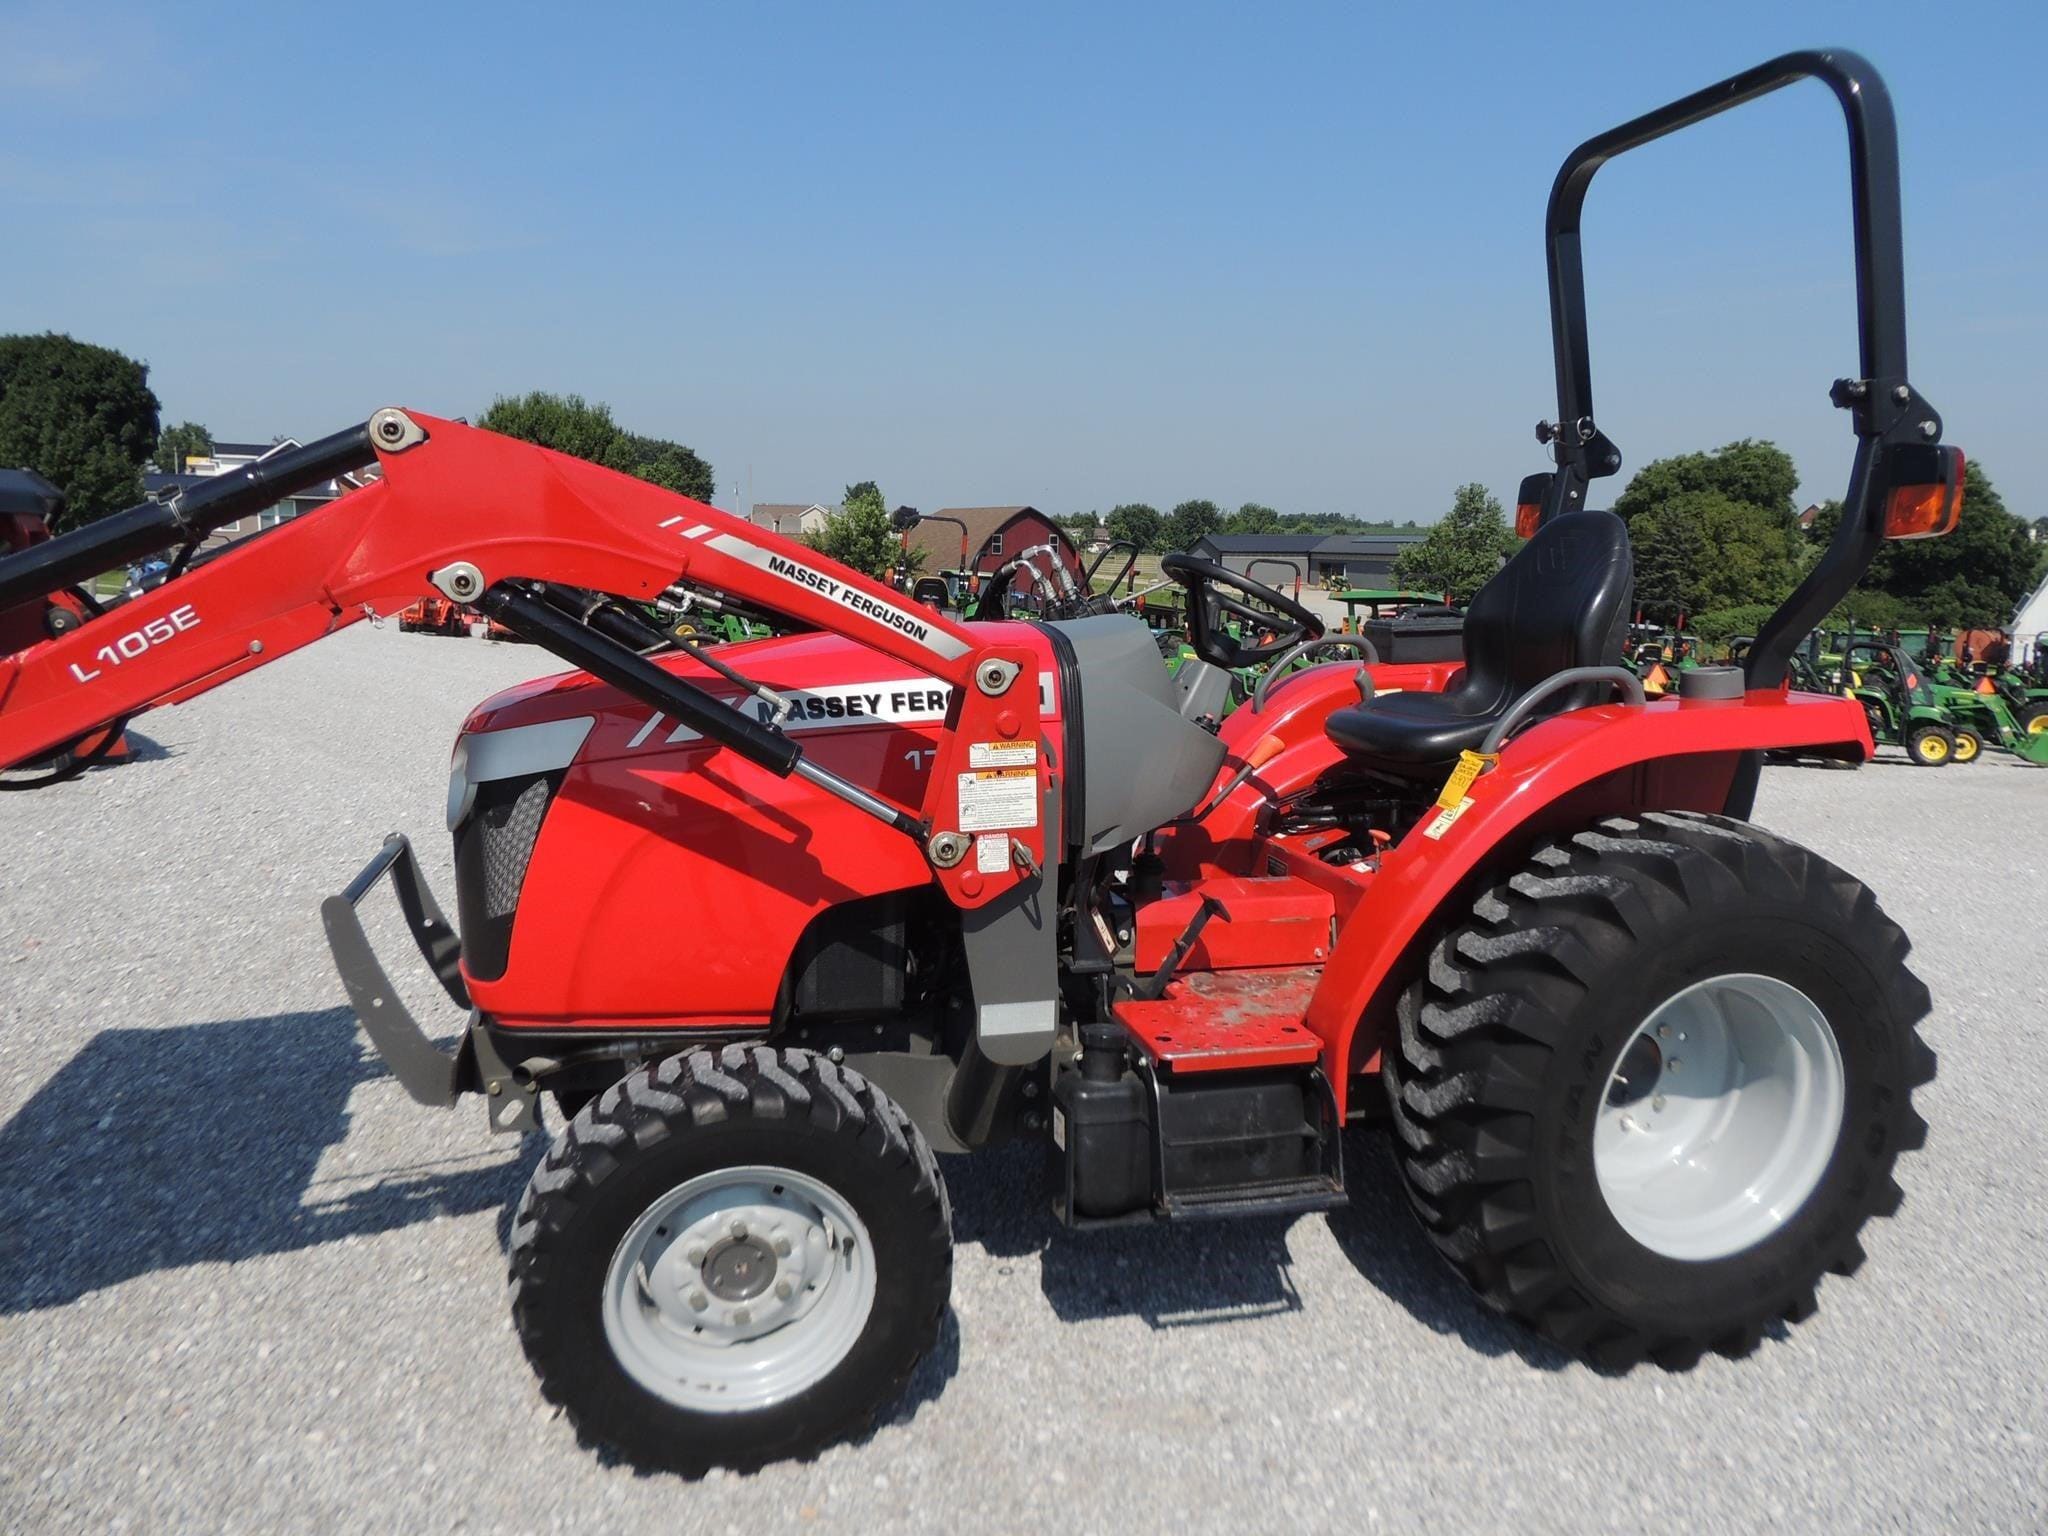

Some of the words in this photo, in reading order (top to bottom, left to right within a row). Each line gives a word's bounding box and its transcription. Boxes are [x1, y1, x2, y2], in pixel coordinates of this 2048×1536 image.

[768, 556, 840, 596] MASSEY
[842, 588, 928, 641] FERGUSON
[757, 694, 883, 722] MASSEY
